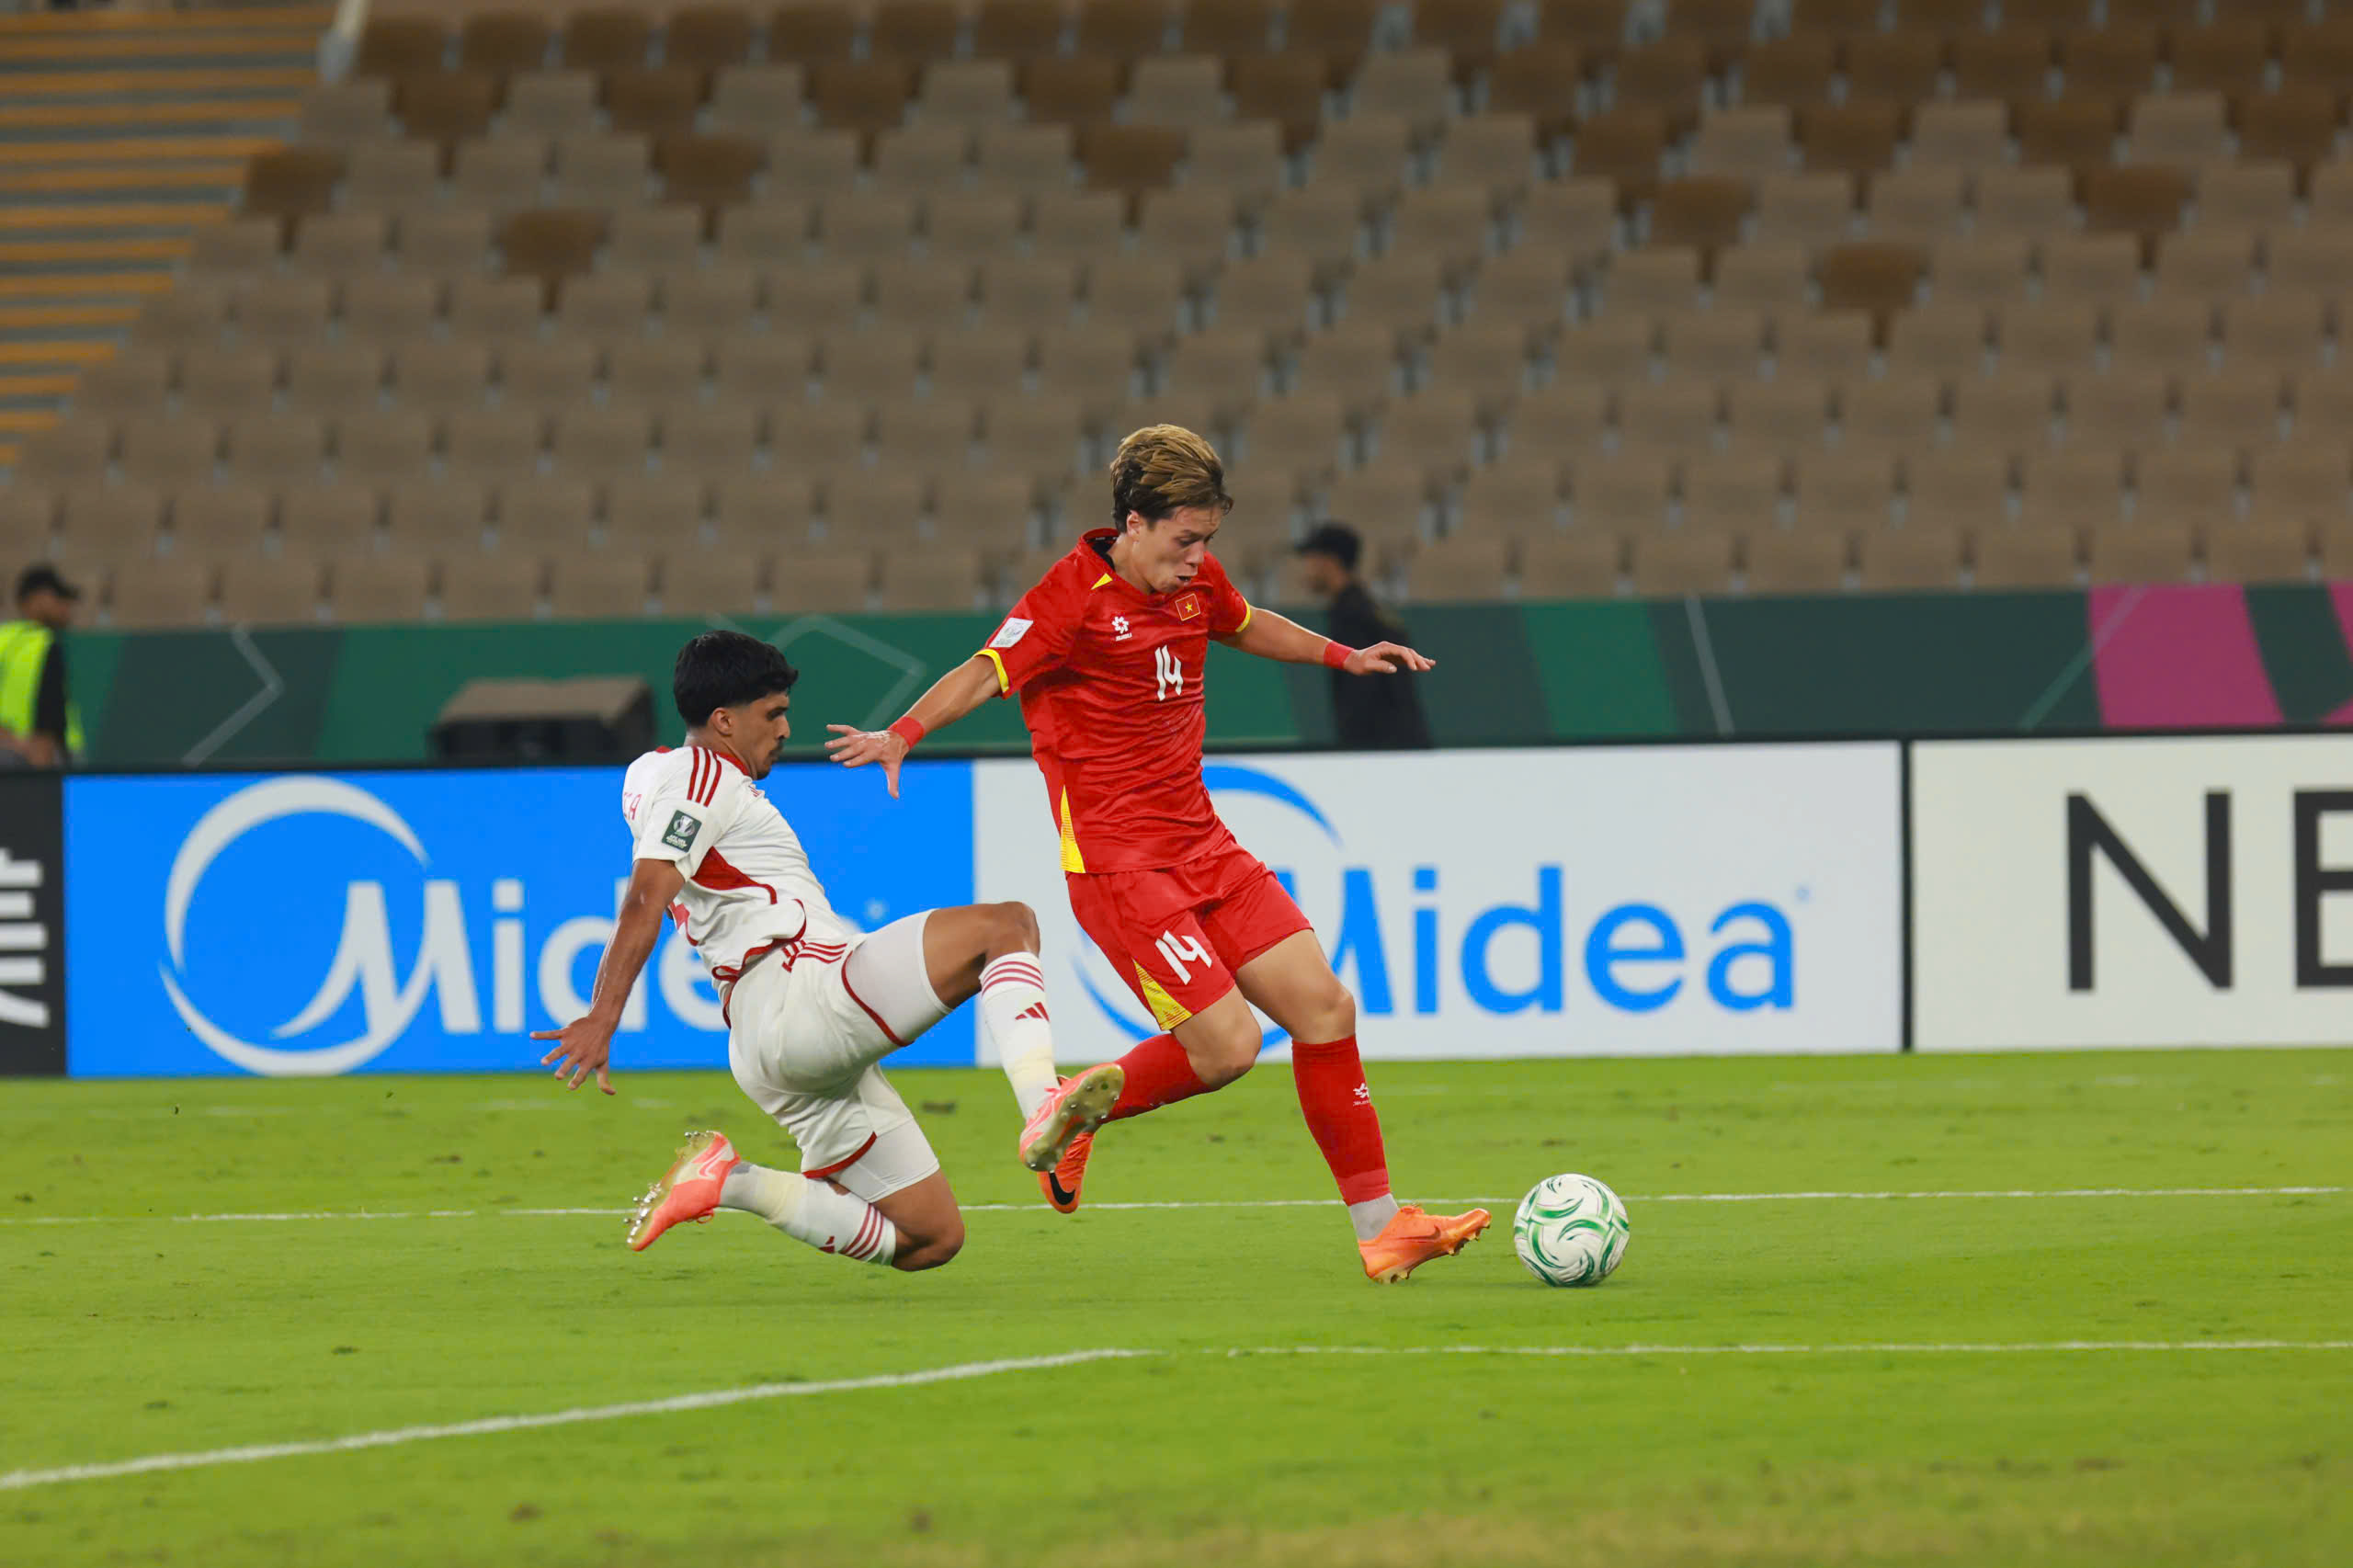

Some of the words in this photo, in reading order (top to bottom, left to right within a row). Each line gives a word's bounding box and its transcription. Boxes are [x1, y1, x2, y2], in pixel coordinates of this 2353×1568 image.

[1154, 644, 1184, 701] 14
[269, 878, 733, 1037] Mide
[1154, 929, 1212, 985] 14
